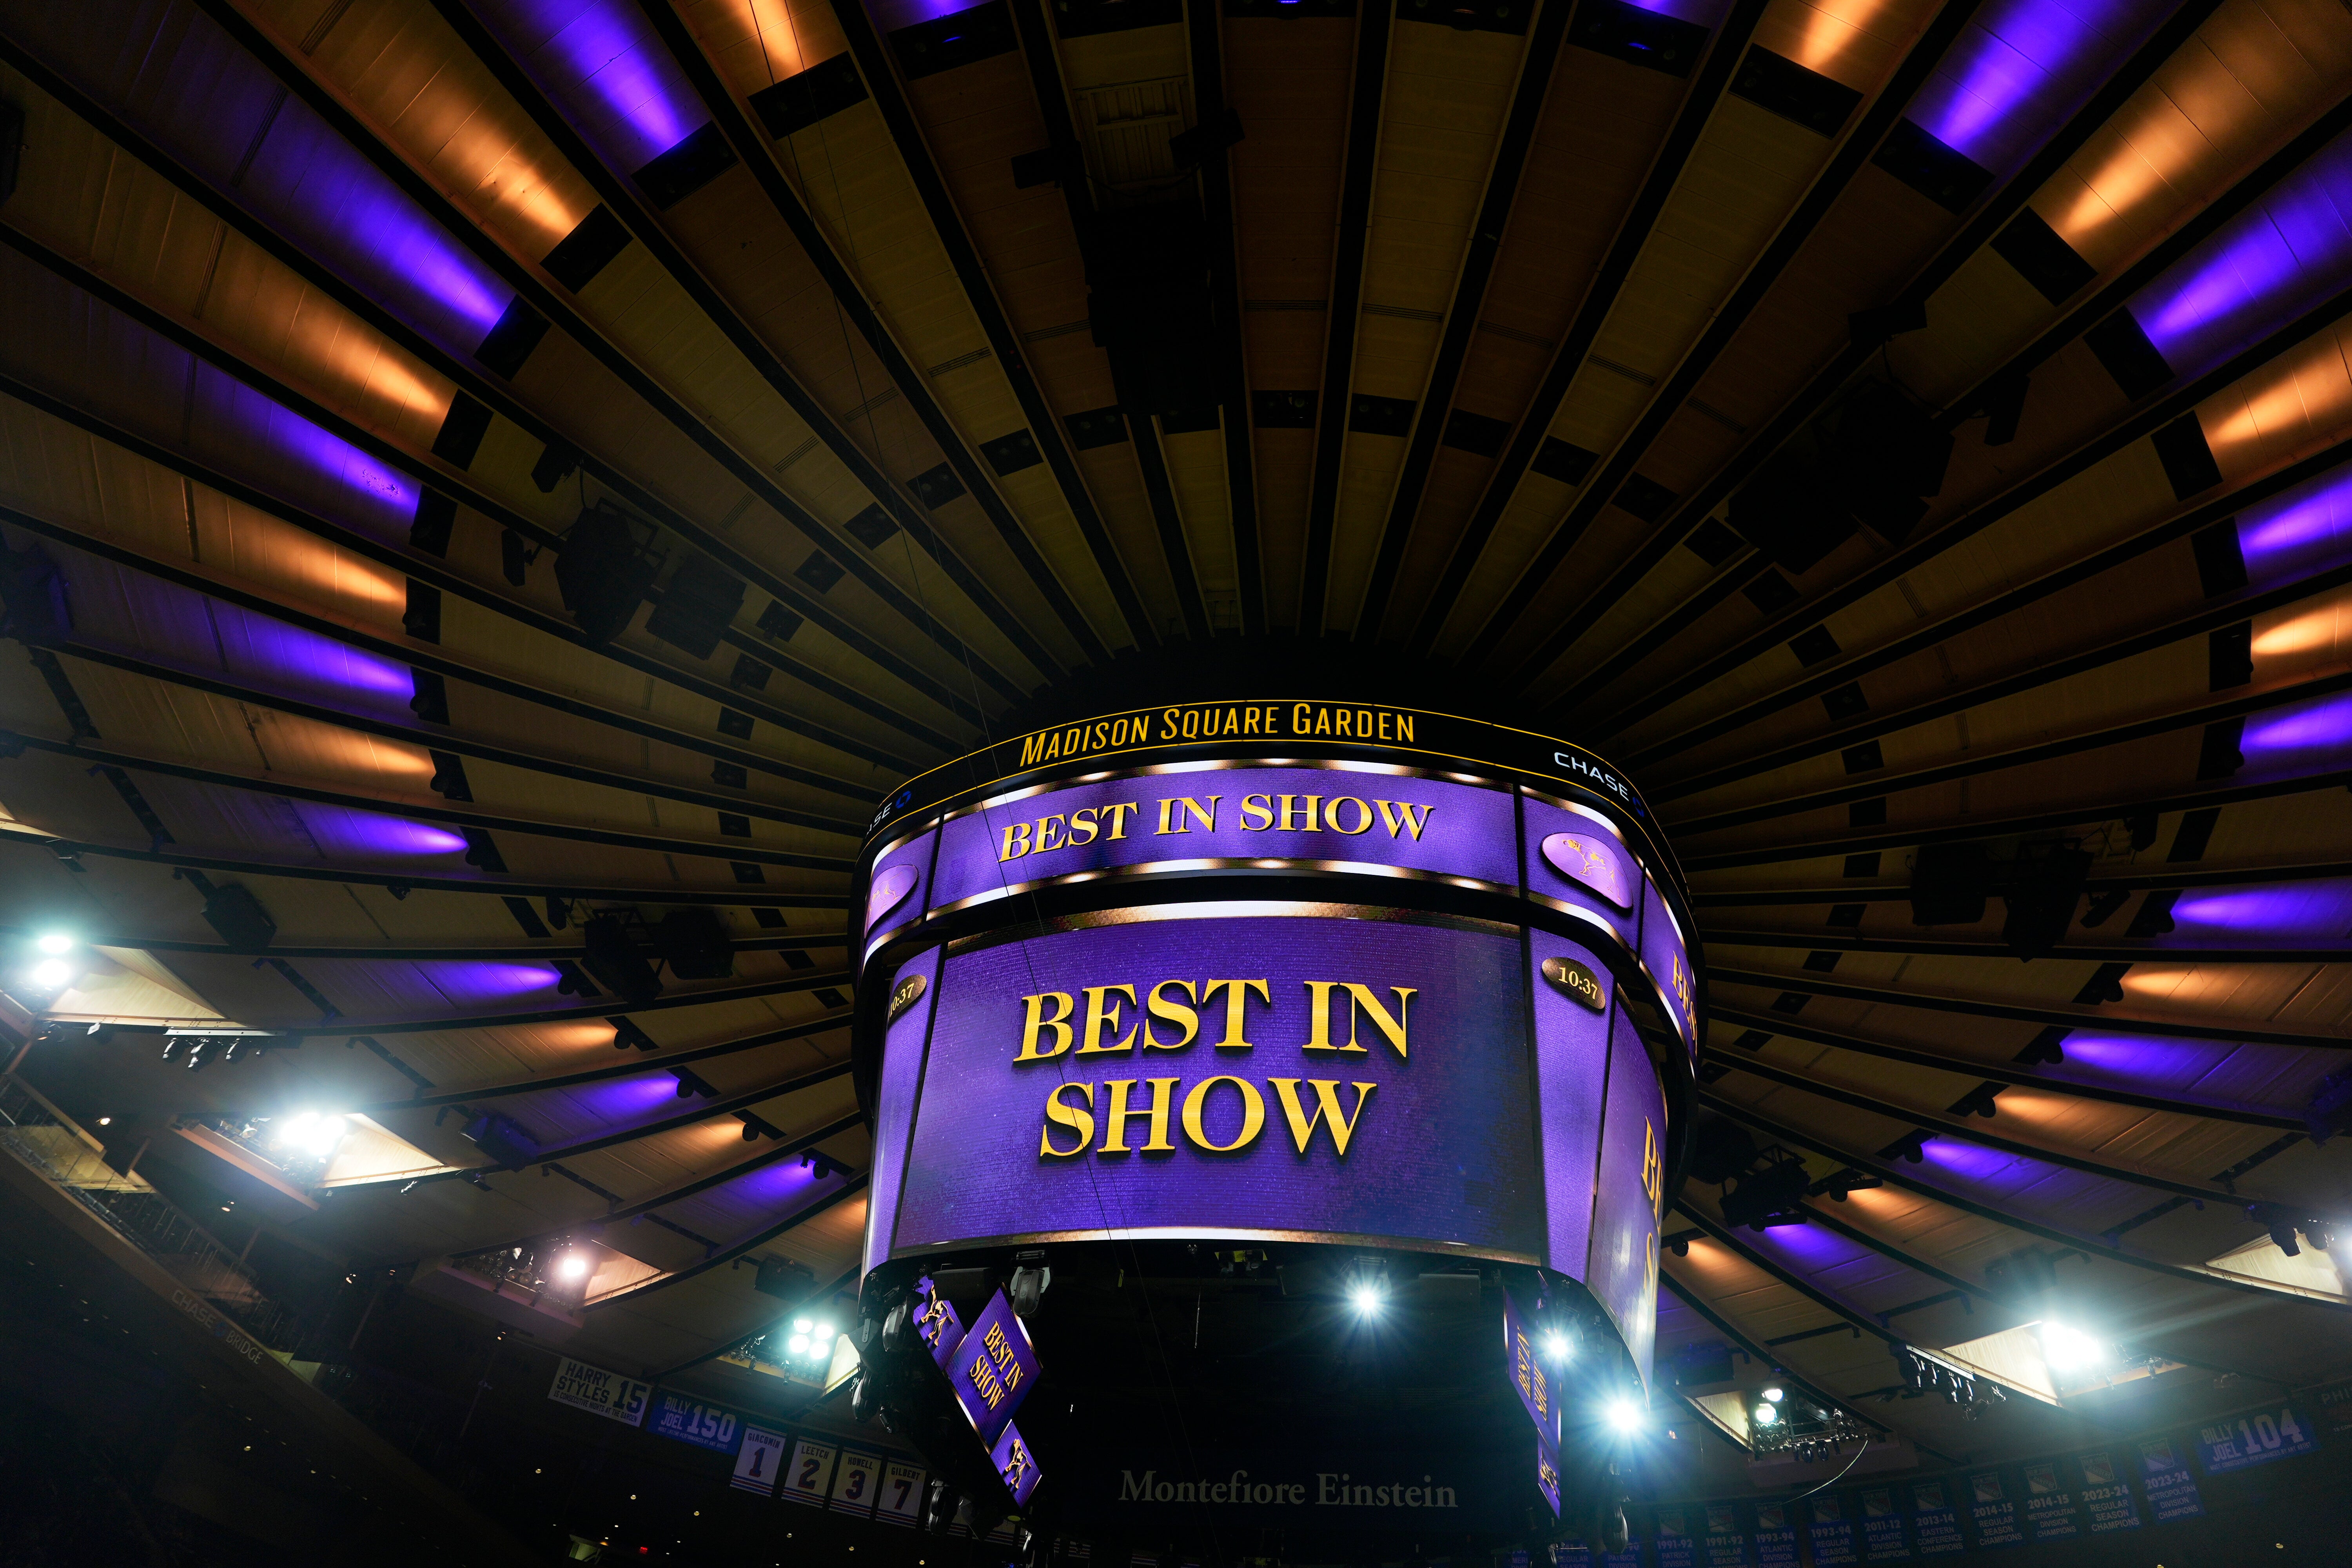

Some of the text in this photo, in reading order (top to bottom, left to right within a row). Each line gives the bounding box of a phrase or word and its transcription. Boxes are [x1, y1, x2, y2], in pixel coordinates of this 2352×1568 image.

[1020, 703, 1414, 767] MADISON SQUARE GARDEN
[1554, 752, 1629, 802] CHASE
[997, 794, 1434, 862] BEST IN SHOW
[1558, 967, 1597, 1000] 10:37
[889, 983, 915, 1018] 10:37
[1013, 978, 1417, 1062] BEST IN
[1040, 1075, 1376, 1156] SHOW
[172, 1289, 263, 1364] CHASE BRIDGE
[984, 1321, 1024, 1392] BEST IN
[565, 1362, 611, 1388] HARRY
[969, 1355, 1005, 1410] SHOW
[557, 1376, 610, 1404] STYLES
[613, 1380, 647, 1414] 15
[560, 1392, 588, 1407] CONSECUTIVE
[589, 1402, 604, 1412] NIGHTS
[605, 1406, 611, 1414] AT
[620, 1412, 638, 1423] GARDEN
[664, 1396, 691, 1415] BILLY
[661, 1412, 683, 1430] JOEL
[687, 1405, 737, 1443] 150
[2201, 1423, 2234, 1445] BILLY
[2238, 1408, 2304, 1455] 104
[748, 1433, 780, 1448] GIACOMIN
[801, 1446, 829, 1459] LEETCH
[2212, 1442, 2241, 1462] JOEL
[749, 1447, 765, 1477] 1
[848, 1457, 873, 1470] HOWELL
[798, 1458, 820, 1490] 2
[891, 1467, 920, 1480] GILBERT
[2145, 1470, 2189, 1490] 2023-24
[846, 1470, 866, 1500] 3
[1118, 1469, 1458, 1508] Montefiore Einstein
[894, 1479, 912, 1510] 7
[2082, 1484, 2129, 1501] 2023-24
[2147, 1485, 2196, 1502] METROPOLITAN
[2028, 1494, 2069, 1509] 2014-15
[2090, 1499, 2129, 1512] REGULAR
[2160, 1496, 2189, 1509] DIVISION
[1973, 1503, 2013, 1517] 2014-15
[2028, 1507, 2076, 1521] METROPOLITAN
[2096, 1509, 2129, 1521] SEASON
[2158, 1504, 2198, 1519] CHAMPIONS
[1864, 1519, 1901, 1532] 2011-12
[1916, 1513, 1955, 1526] 2013-14
[1978, 1516, 2014, 1528] REGULAR
[2040, 1517, 2068, 1528] DIVISION
[2092, 1517, 2140, 1532] CHAMPIONS
[1755, 1532, 1795, 1543] 1993-94
[1811, 1525, 1851, 1538] 1993-94
[1868, 1532, 1902, 1542] ATLANTIC
[1921, 1526, 1954, 1537] EASTERN
[1984, 1525, 2014, 1536] SEASON
[2037, 1526, 2076, 1537] CHAMPIONS
[1657, 1539, 1693, 1550] 1991-92
[1706, 1535, 1744, 1546] 1991-92
[1816, 1538, 1850, 1548] REGULAR
[1871, 1541, 1902, 1551] DIVISION
[1917, 1534, 1963, 1546] CONFERENCE
[1979, 1533, 2022, 1546] CHAMPIONS
[1709, 1548, 1742, 1556] REGULAR
[1760, 1544, 1793, 1553] ATLANTIC
[1820, 1547, 1849, 1556] SEASON
[1867, 1549, 1910, 1560] CHAMPIONS
[1921, 1543, 1963, 1554] CHAMPIONS
[1662, 1560, 1691, 1568] DIVISION
[1713, 1557, 1741, 1565] SEASON
[1763, 1553, 1793, 1562] DIVISION
[1815, 1555, 1857, 1565] CHAMPIONS
